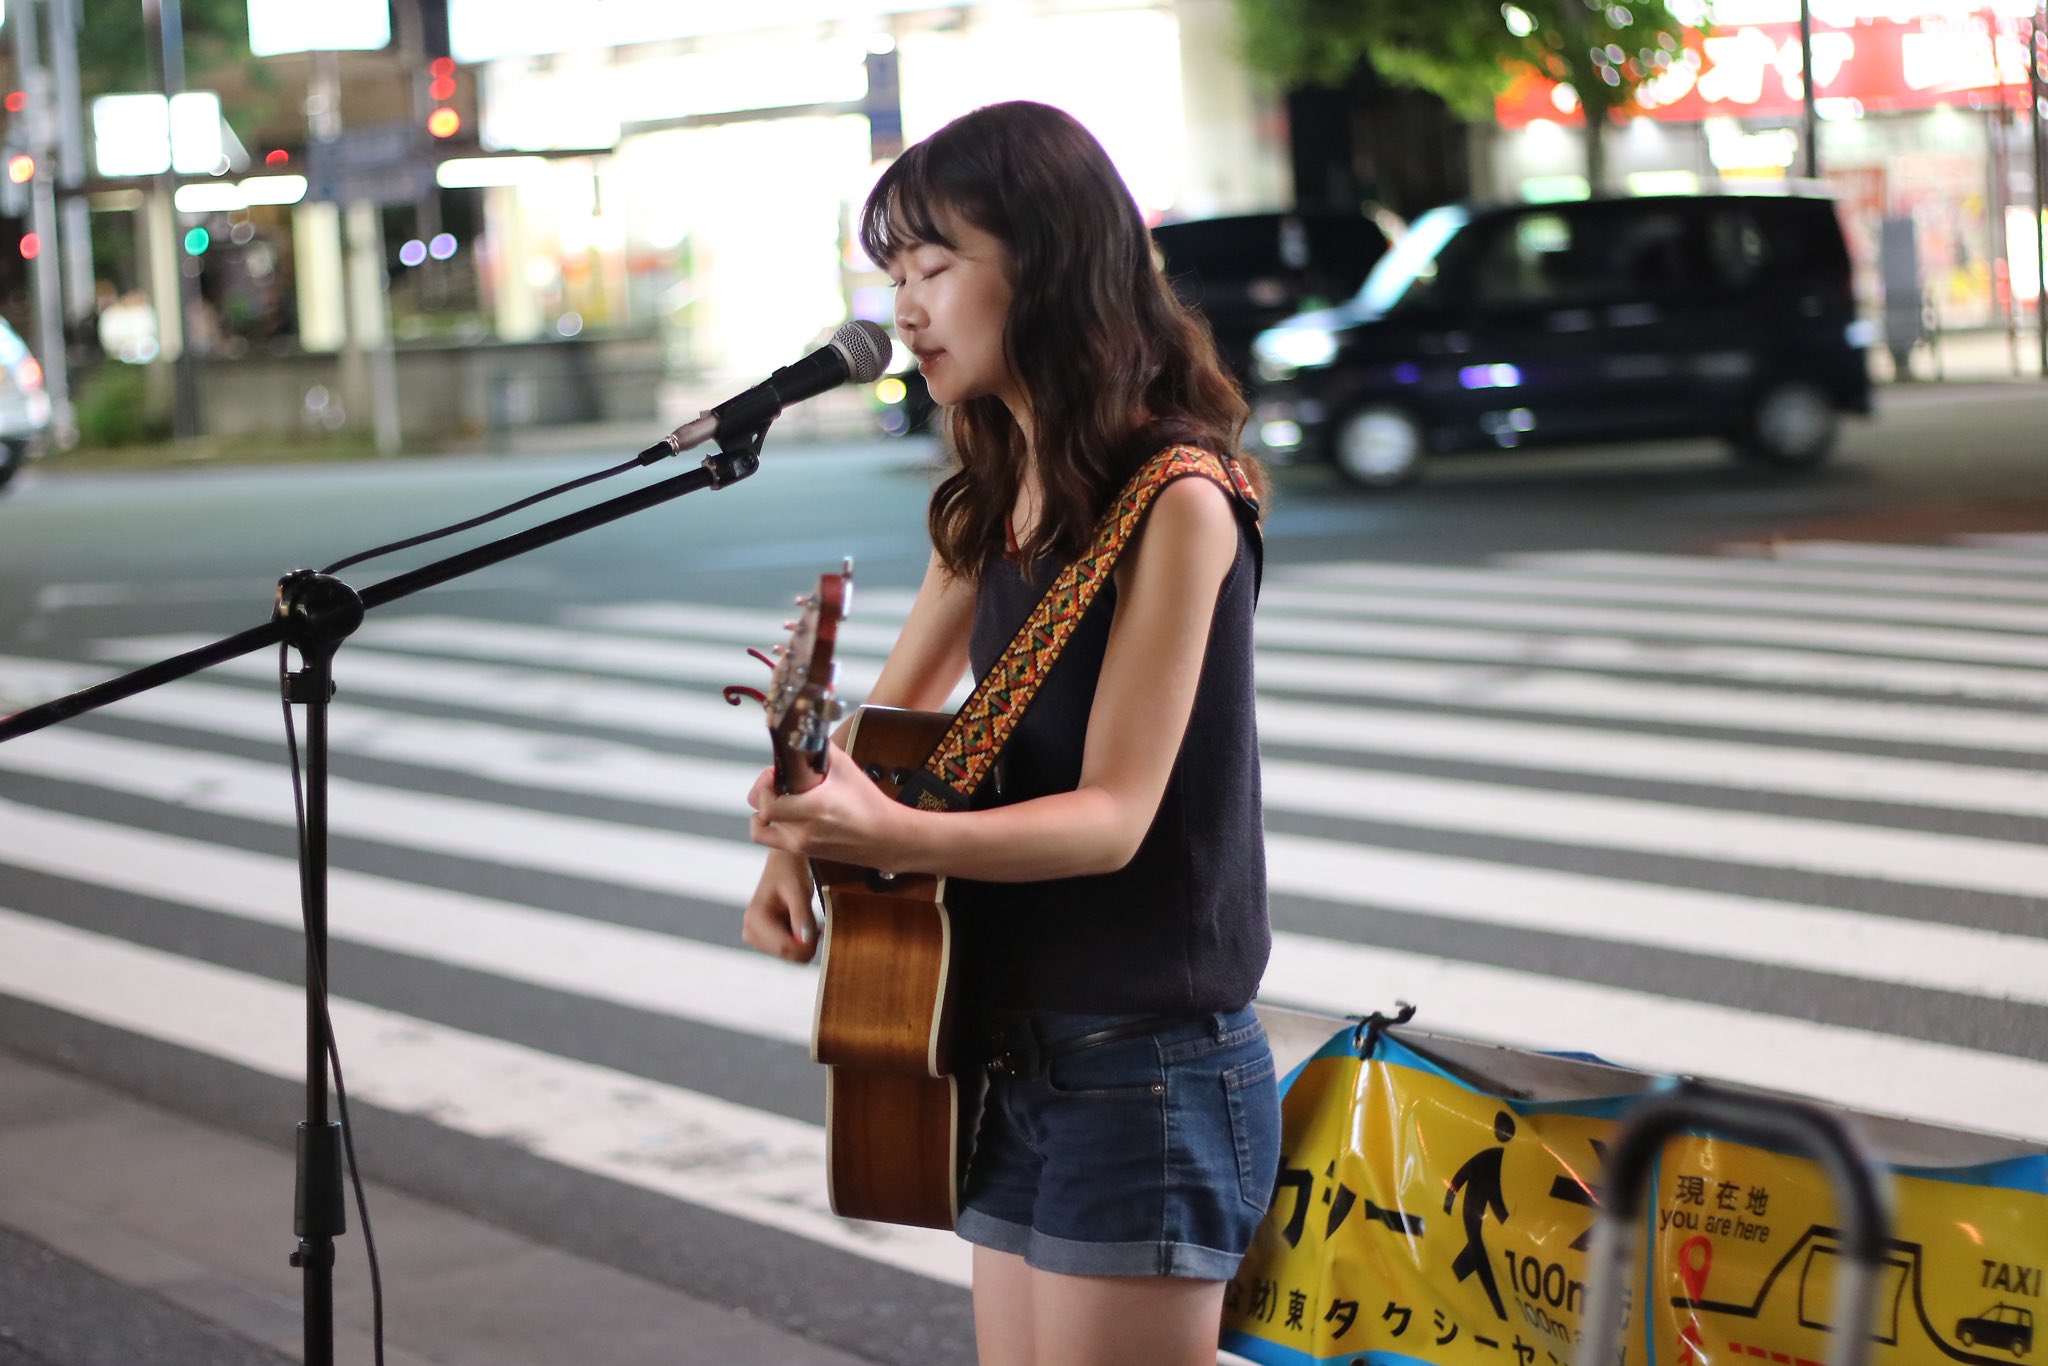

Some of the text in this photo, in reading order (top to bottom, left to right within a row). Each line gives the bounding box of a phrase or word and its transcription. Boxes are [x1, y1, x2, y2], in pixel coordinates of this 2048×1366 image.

[1675, 1174, 1769, 1217] 現在地
[1660, 1208, 1770, 1244] you are here
[1981, 1259, 2042, 1298] TAXI
